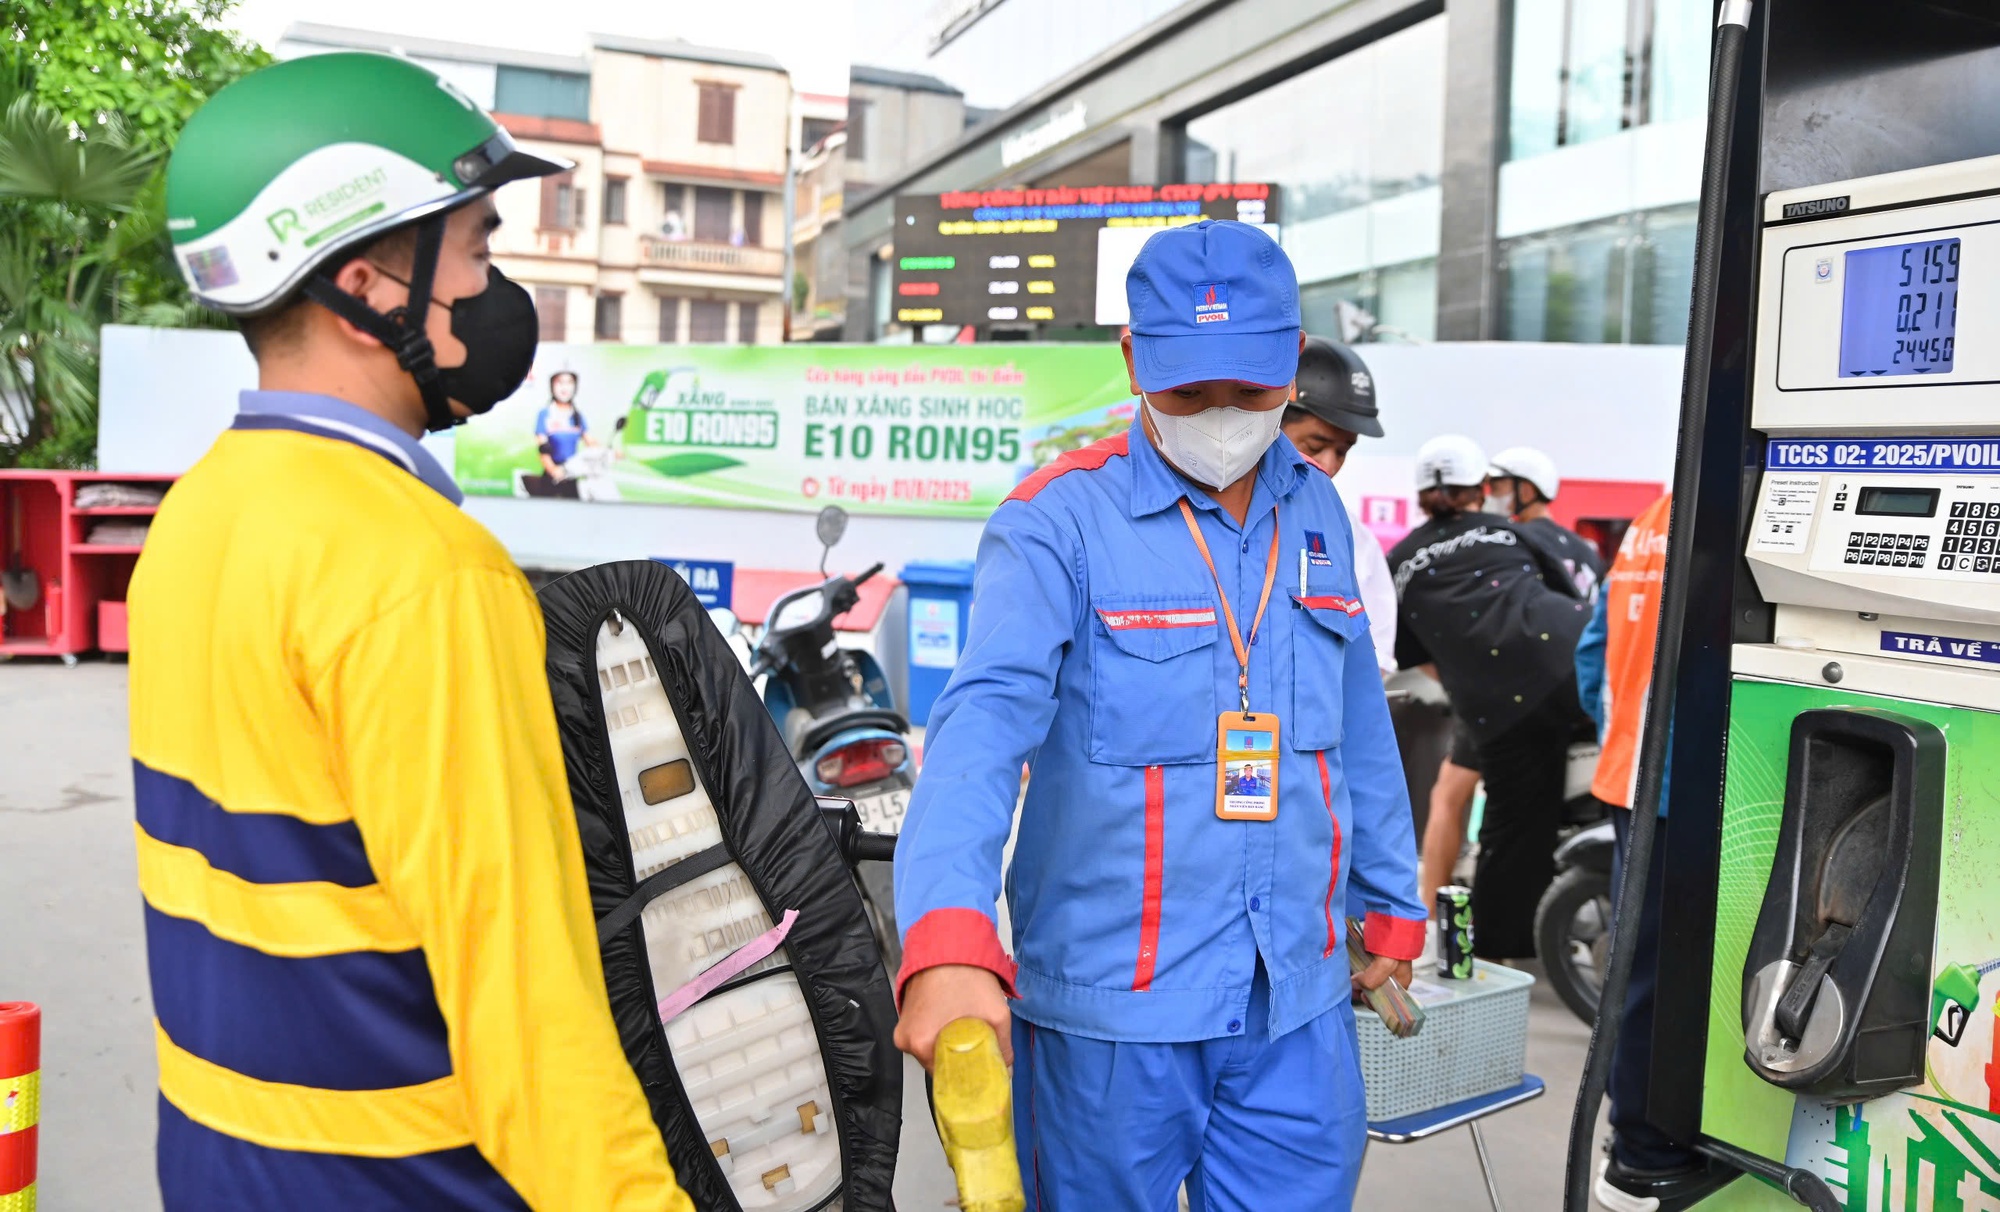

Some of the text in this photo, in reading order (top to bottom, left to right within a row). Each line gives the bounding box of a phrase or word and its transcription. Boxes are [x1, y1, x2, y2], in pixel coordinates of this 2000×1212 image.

[1785, 197, 1848, 217] TATSUNO
[1899, 243, 1961, 287] 5159
[1198, 313, 1226, 322] PVOIL
[1896, 291, 1957, 334] 0,211
[1892, 337, 1955, 364] 24450
[805, 391, 848, 418] BÁN
[919, 396, 970, 418] SINH
[647, 410, 776, 446] E10 RON95
[804, 423, 1020, 463] E10 RON95
[1777, 443, 2000, 466] TCCS 02: 2025/PVOIL
[1954, 504, 2000, 517] 7 8 9
[1950, 522, 1995, 535] 4 5 6
[1850, 535, 1928, 547] P1 P2 P3 P4 P5
[1963, 540, 1973, 552] 2
[1981, 541, 1991, 553] 3
[1846, 552, 1925, 565] P6 P7 P8 P9 P10
[1941, 556, 1951, 568] 0
[1959, 558, 1970, 569] C
[692, 567, 720, 590] RA
[1894, 636, 1943, 653] TRẢ
